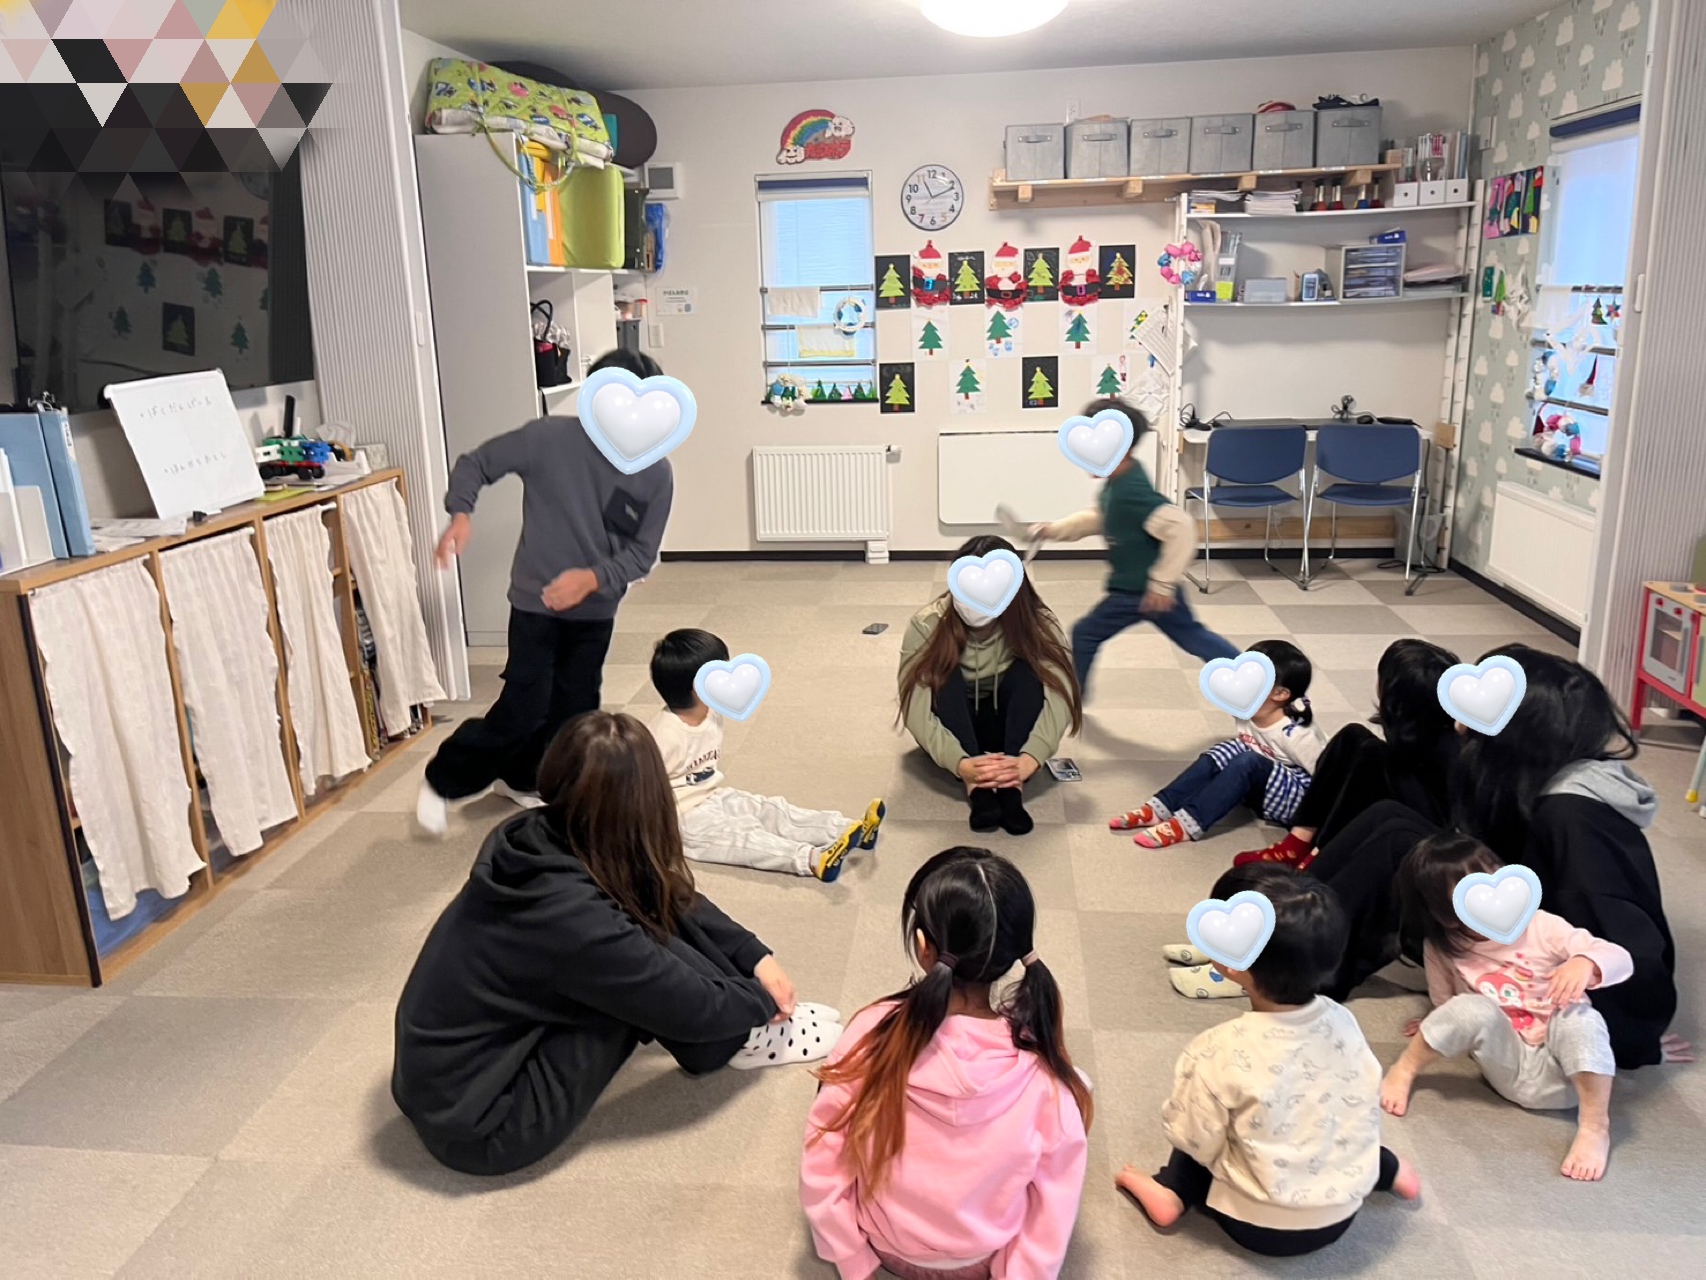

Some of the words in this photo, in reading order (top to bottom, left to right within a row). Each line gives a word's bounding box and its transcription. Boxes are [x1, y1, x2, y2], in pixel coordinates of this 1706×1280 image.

[917, 174, 926, 183] 11
[927, 170, 937, 179] 12
[908, 184, 919, 193] 10
[949, 180, 955, 190] 2
[906, 194, 912, 204] 9
[953, 192, 960, 201] 3
[910, 206, 917, 215] 8
[949, 204, 955, 213] 4
[918, 214, 925, 223] 7
[930, 216, 937, 226] 6
[941, 212, 947, 222] 5
